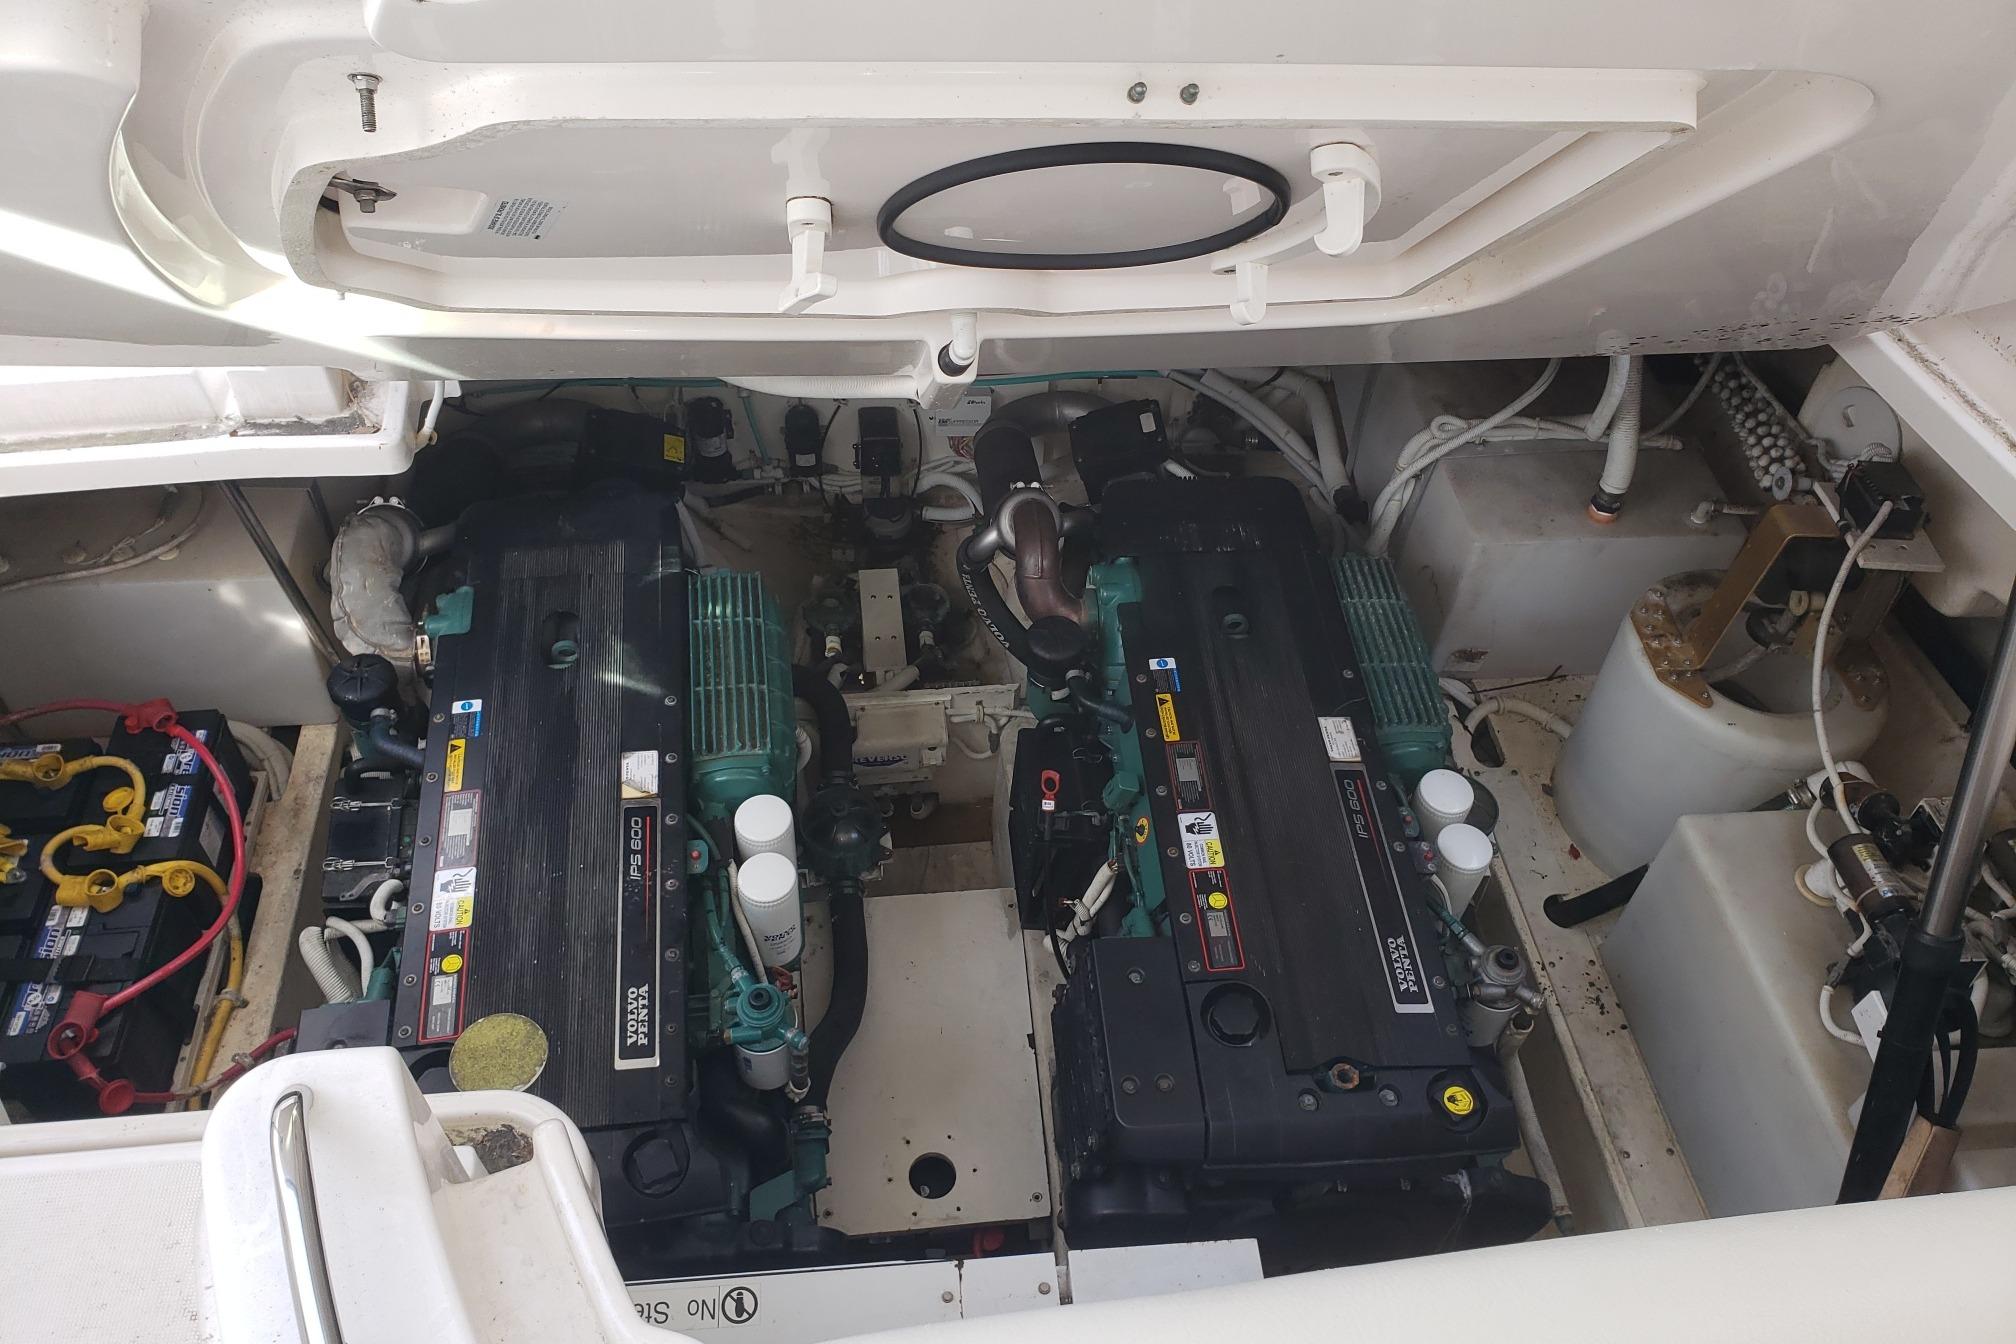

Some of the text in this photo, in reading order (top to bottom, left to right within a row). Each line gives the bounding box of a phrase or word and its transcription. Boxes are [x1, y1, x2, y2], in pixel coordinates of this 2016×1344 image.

[977, 607, 1010, 649] VOLVO
[1343, 779, 1361, 811] 600
[1352, 816, 1369, 839] IPS
[630, 816, 642, 880] IPS 600
[1187, 850, 1196, 866] VOLTS
[1206, 841, 1216, 864] CAUTION
[434, 911, 442, 928] VOLTS
[456, 900, 465, 925] CAUTION
[1387, 937, 1409, 993] VOLVO
[1397, 935, 1419, 993] PENTA
[627, 986, 638, 1047] VOLVO
[637, 983, 649, 1047] PENTA
[687, 1298, 716, 1321] No
